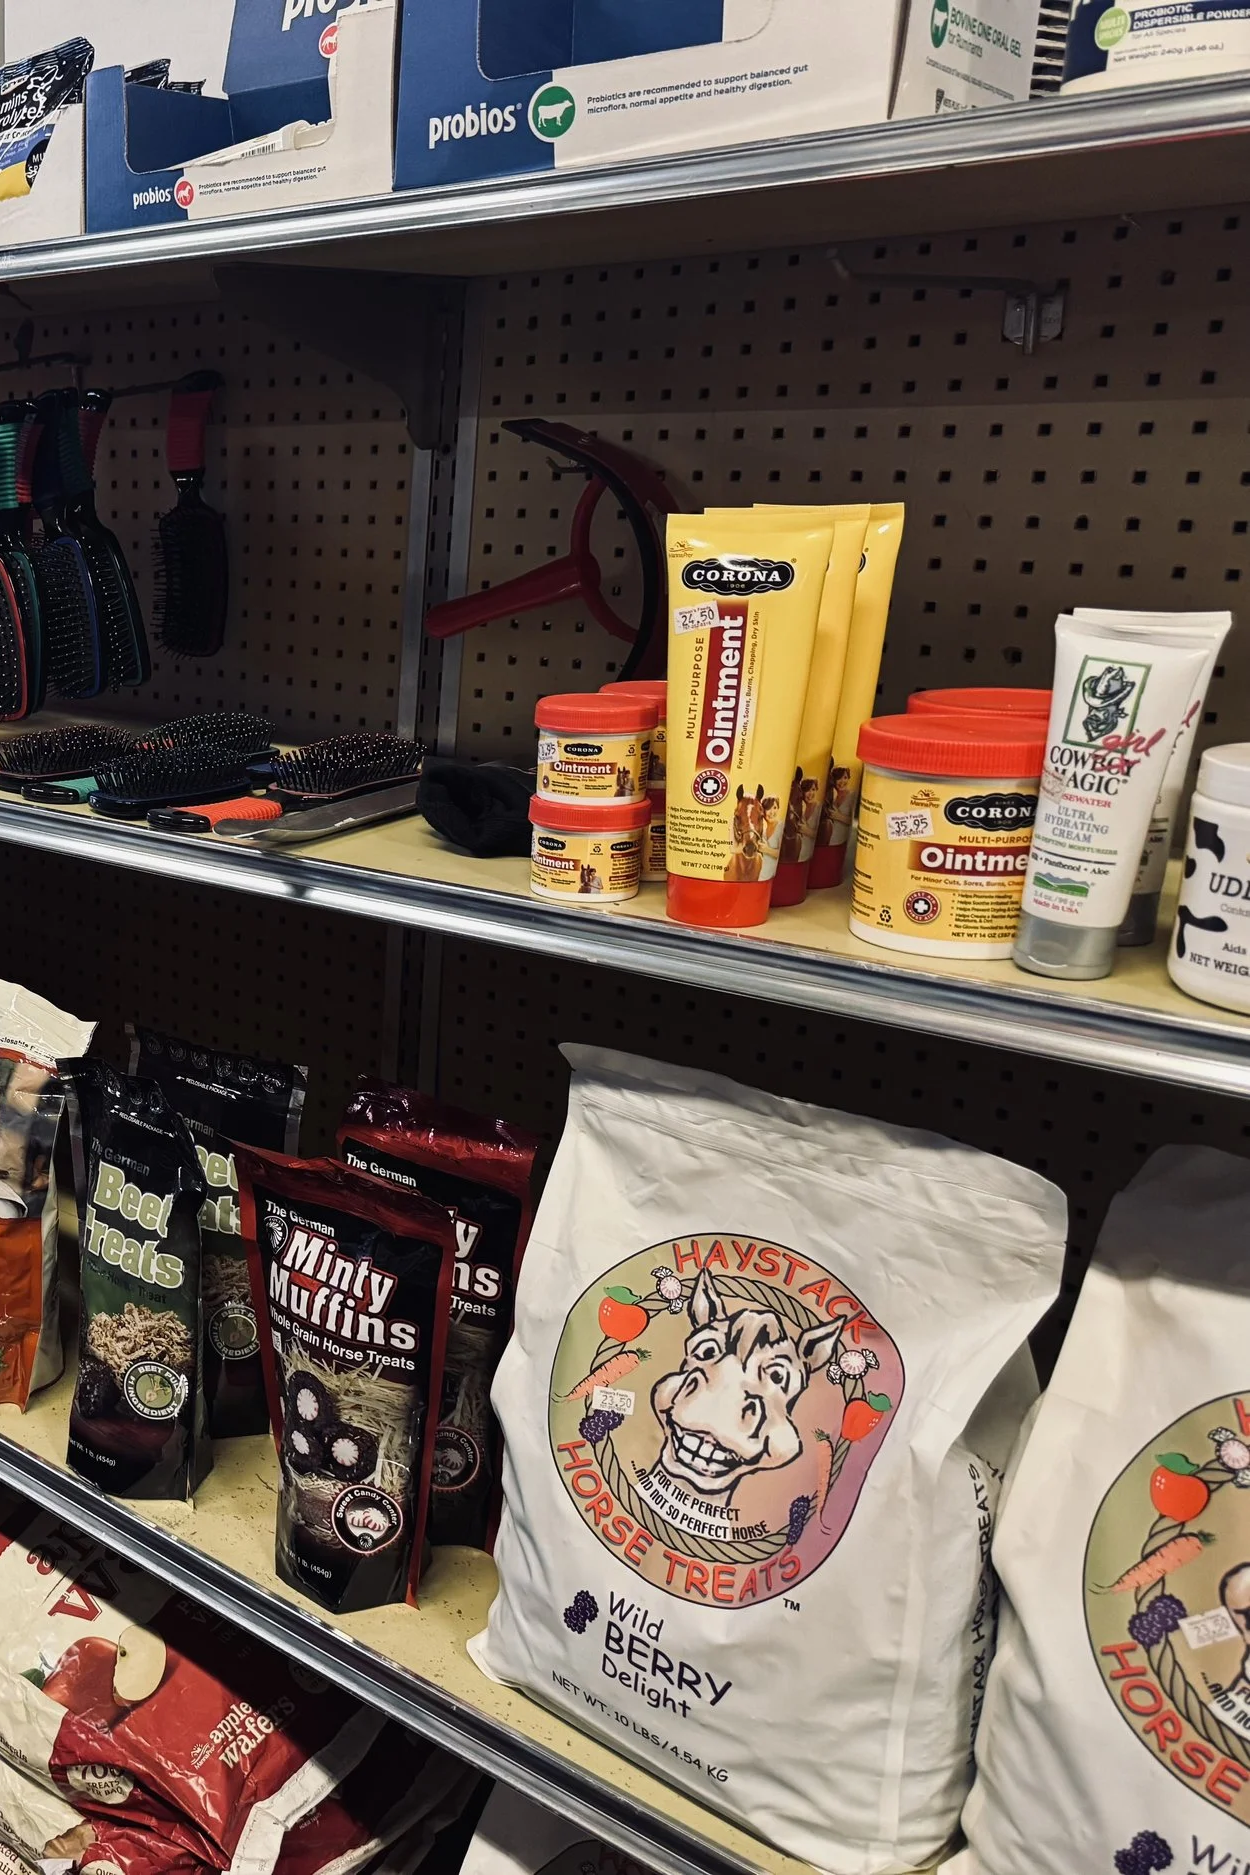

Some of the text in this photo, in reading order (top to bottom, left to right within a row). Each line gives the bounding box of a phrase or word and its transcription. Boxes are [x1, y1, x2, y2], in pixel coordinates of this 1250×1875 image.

[1133, 12, 1204, 29] DISPERSIBLE
[1135, 4, 1193, 20] PROBIOTIC
[950, 7, 1021, 57] BOVINE ONE ORAL GEL
[587, 92, 626, 104] Probiotics
[628, 90, 641, 98] are
[643, 80, 701, 95] recommended
[714, 74, 748, 88] support
[750, 67, 790, 79] balanced
[793, 64, 808, 76] gut
[587, 78, 792, 115] microflora, normal appetite and healthy digestion.
[199, 167, 316, 190] Probiotics recommended support balanced
[273, 177, 292, 186] healthy
[692, 570, 781, 581] CORONA
[681, 609, 714, 627] 24.50
[686, 638, 704, 739] MULTI-PURPOSE
[706, 616, 743, 763] Ointment
[1102, 728, 1166, 756] girl
[554, 762, 611, 774] Ointment
[697, 770, 726, 784] FIRST AID
[895, 818, 929, 834] 35.95
[1044, 813, 1109, 835] HYDRATING
[1057, 806, 1094, 821] ULTRA
[1052, 827, 1092, 843] CREAM
[920, 847, 1028, 871] Ointme
[1044, 857, 1110, 876] Panthenol Aloe
[1190, 952, 1210, 967] NET
[1222, 943, 1247, 955] Aids
[119, 1112, 143, 1127] RECLOSABLE
[104, 1148, 150, 1176] German
[346, 1153, 417, 1188] The German
[93, 1160, 174, 1238] Beet
[265, 1199, 335, 1238] The German
[282, 1229, 394, 1314] Minty
[270, 1260, 416, 1351] Muffins
[672, 1239, 878, 1345] HAYSTACK
[292, 1323, 415, 1371] Grain Horse Treats
[138, 1365, 164, 1374] BEET
[127, 1387, 179, 1416] INGREDIENT
[600, 1395, 632, 1409] 23.50
[96, 1453, 116, 1467] (454g)
[336, 1490, 398, 1526] Sweet Candy Center
[557, 1438, 654, 1567] HORSE
[653, 1469, 741, 1522] FOR THE PERFECT
[649, 1487, 770, 1540] NOT SO PERFECT HORSE
[310, 1563, 332, 1578] (454g)
[662, 1546, 802, 1602] TREATS
[609, 1591, 664, 1642] Wild
[783, 1597, 801, 1612] TM
[605, 1620, 733, 1706] BERRY
[601, 1653, 692, 1718] Delight
[209, 1702, 252, 1744] apple
[552, 1670, 729, 1782] NET WT. 10 KG
[1100, 1641, 1250, 1806] HORSE
